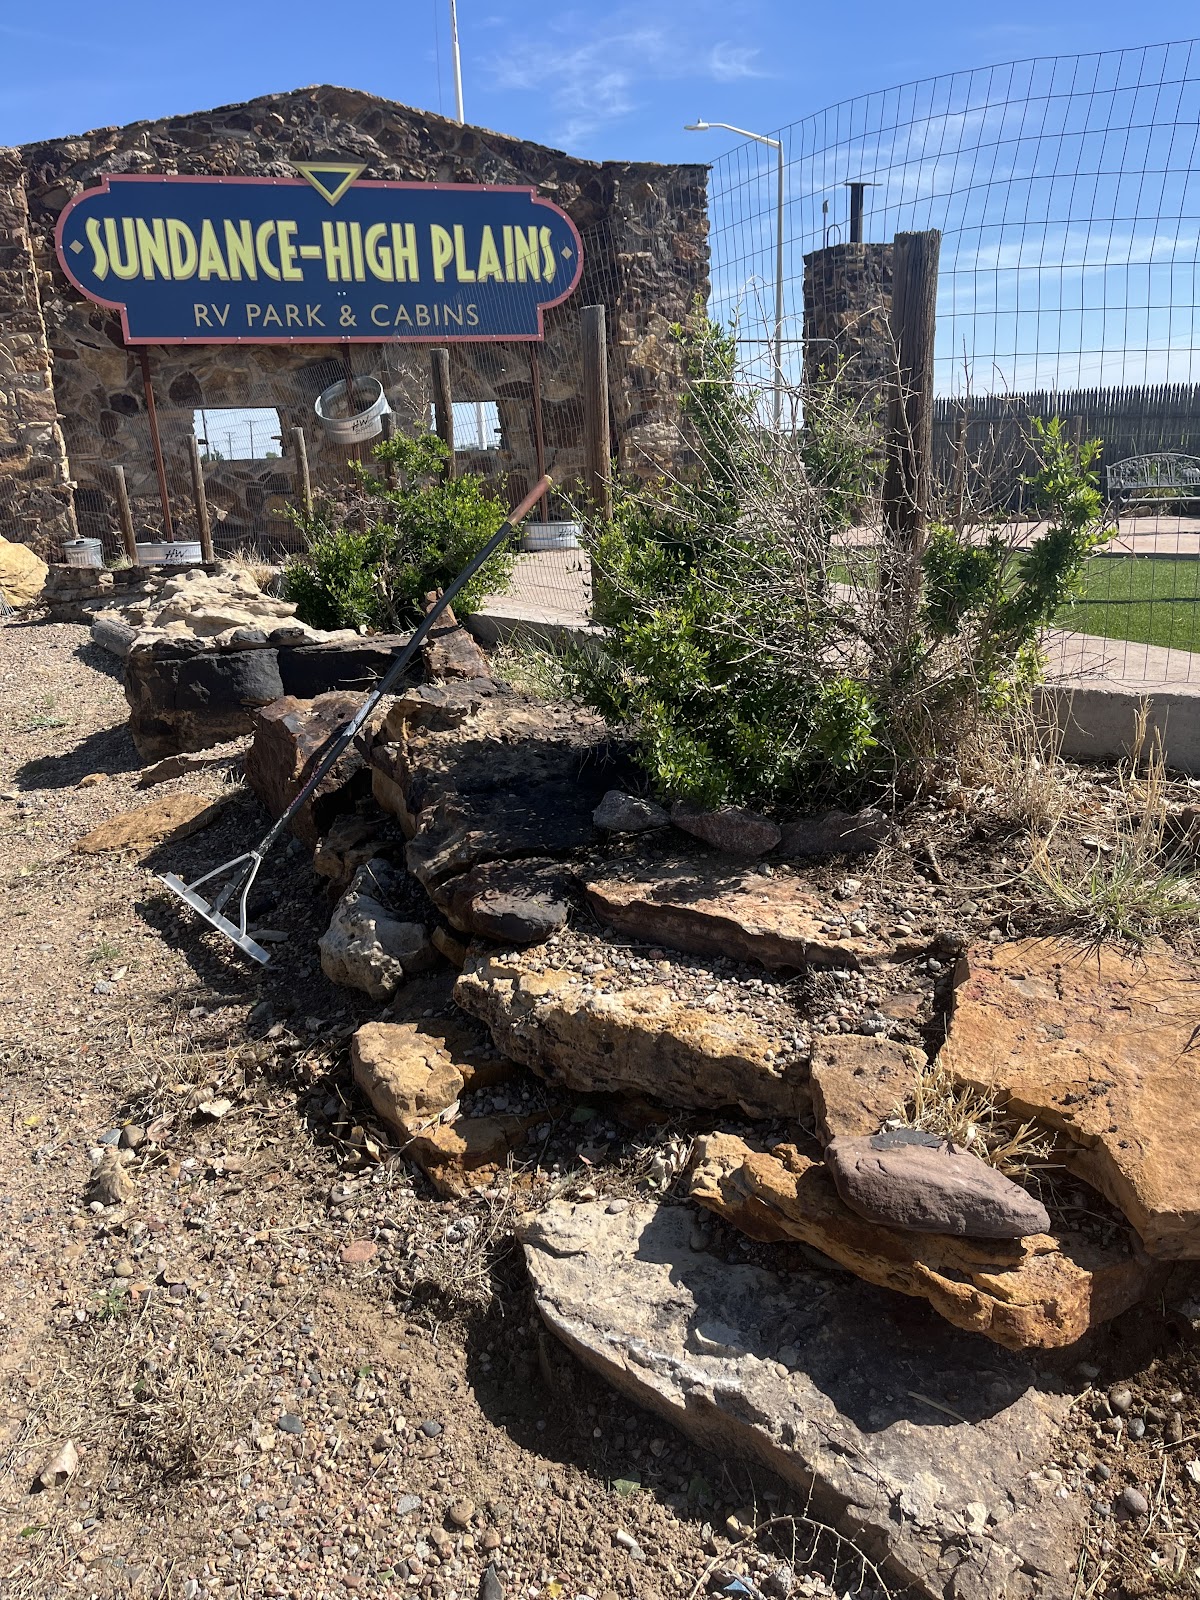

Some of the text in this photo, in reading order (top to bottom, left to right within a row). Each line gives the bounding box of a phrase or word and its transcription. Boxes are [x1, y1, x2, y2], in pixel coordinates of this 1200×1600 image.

[85, 217, 557, 283] SUNDANCE-HIGH PLAINS
[194, 303, 479, 327] RV PARK & CABINS
